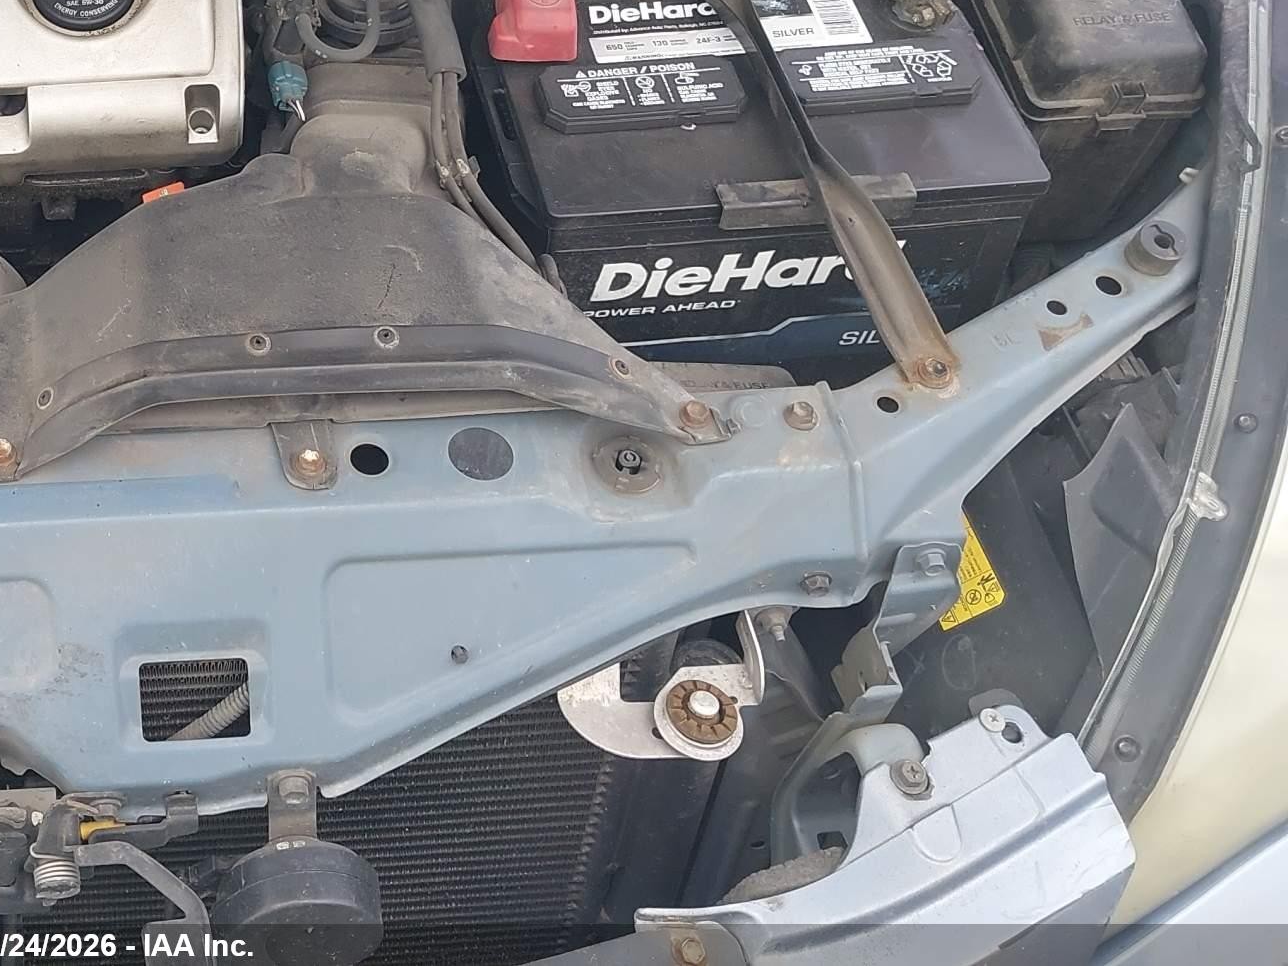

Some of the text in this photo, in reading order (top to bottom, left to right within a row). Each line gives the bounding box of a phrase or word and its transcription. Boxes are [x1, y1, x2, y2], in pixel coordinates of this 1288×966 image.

[53, 2, 78, 16] ENERGY
[772, 28, 814, 38] SILVER
[588, 66, 638, 78] DANGER
[650, 62, 696, 72] POISON
[590, 240, 906, 302] DieHar
[584, 299, 737, 319] POWER AHEAD
[839, 331, 881, 346] SIL
